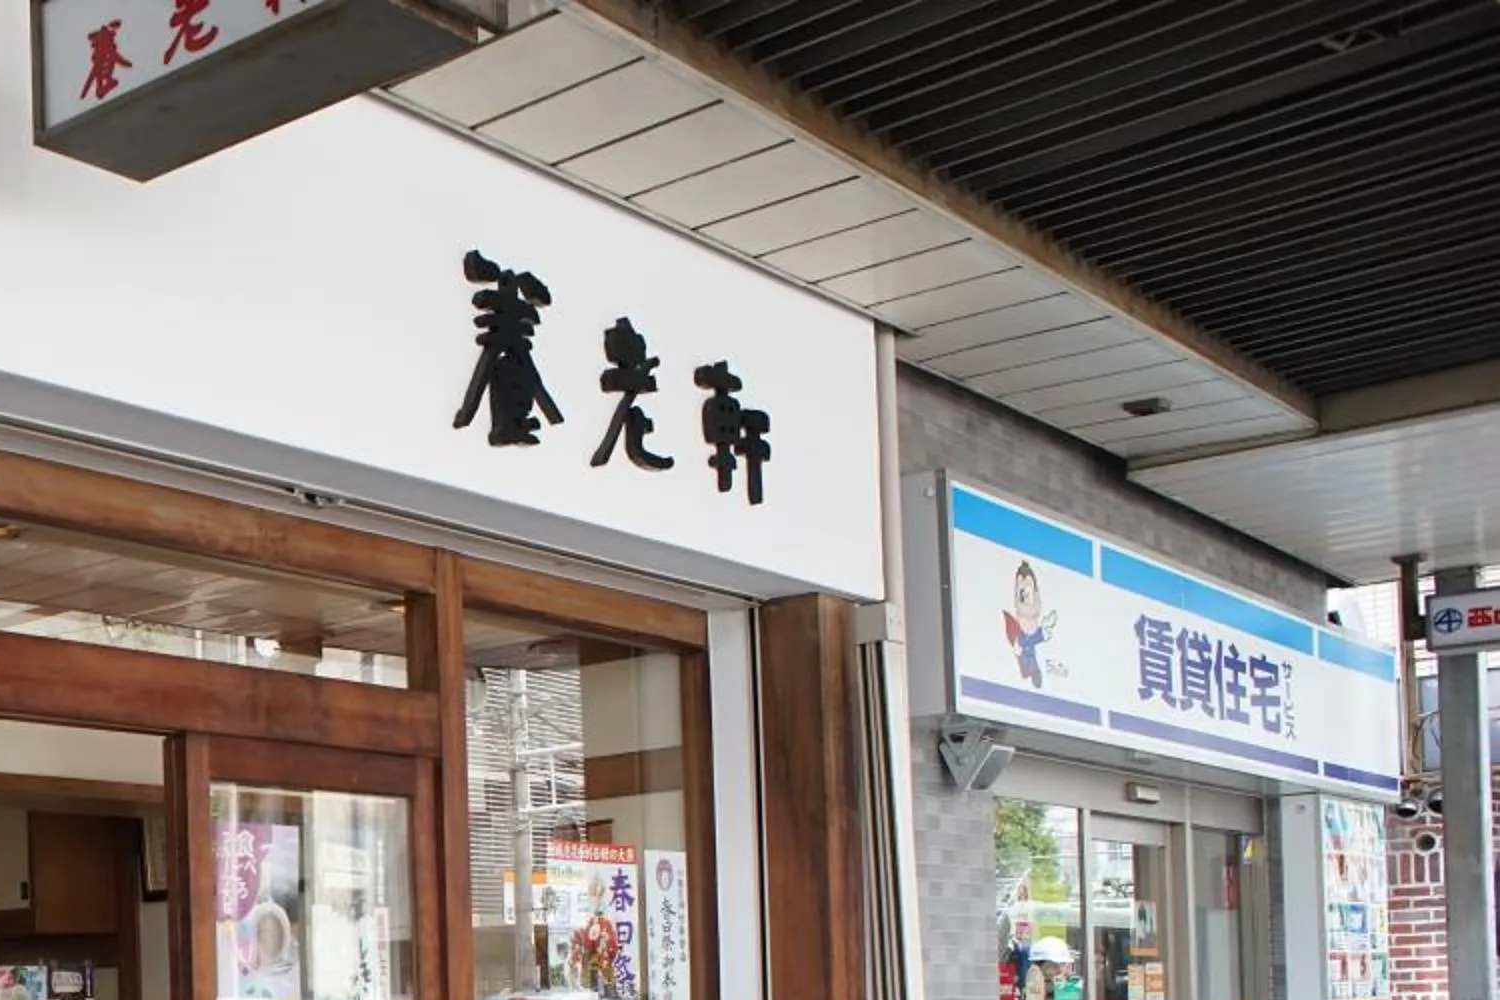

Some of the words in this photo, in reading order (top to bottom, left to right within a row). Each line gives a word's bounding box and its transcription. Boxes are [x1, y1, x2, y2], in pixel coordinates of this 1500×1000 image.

[79, 0, 280, 99] 養老
[452, 249, 772, 505] 養老軒
[1468, 605, 1500, 628] 西
[1134, 613, 1281, 734] 賃貸住宅
[1280, 659, 1297, 740] サービス
